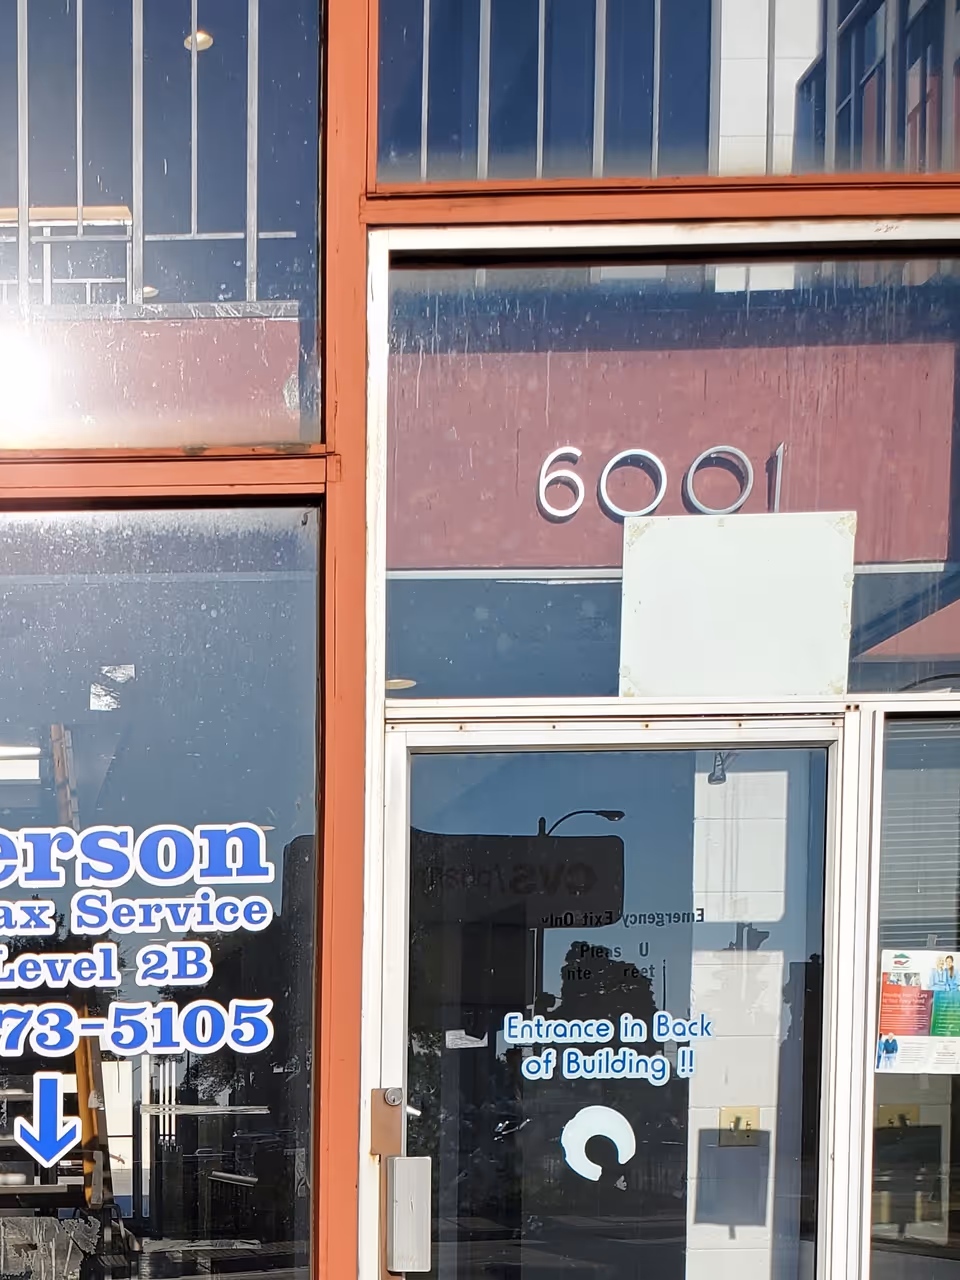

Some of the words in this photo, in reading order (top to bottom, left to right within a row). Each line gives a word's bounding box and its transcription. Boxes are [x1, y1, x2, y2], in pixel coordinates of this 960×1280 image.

[538, 441, 787, 519] 6001
[75, 889, 270, 931] Service
[139, 944, 211, 983] 2B
[506, 1014, 611, 1039] Entrance
[622, 1015, 645, 1038] in
[655, 1013, 713, 1038] Back
[525, 1051, 553, 1076] of
[565, 1049, 667, 1081] Building
[680, 1049, 695, 1073] !!
